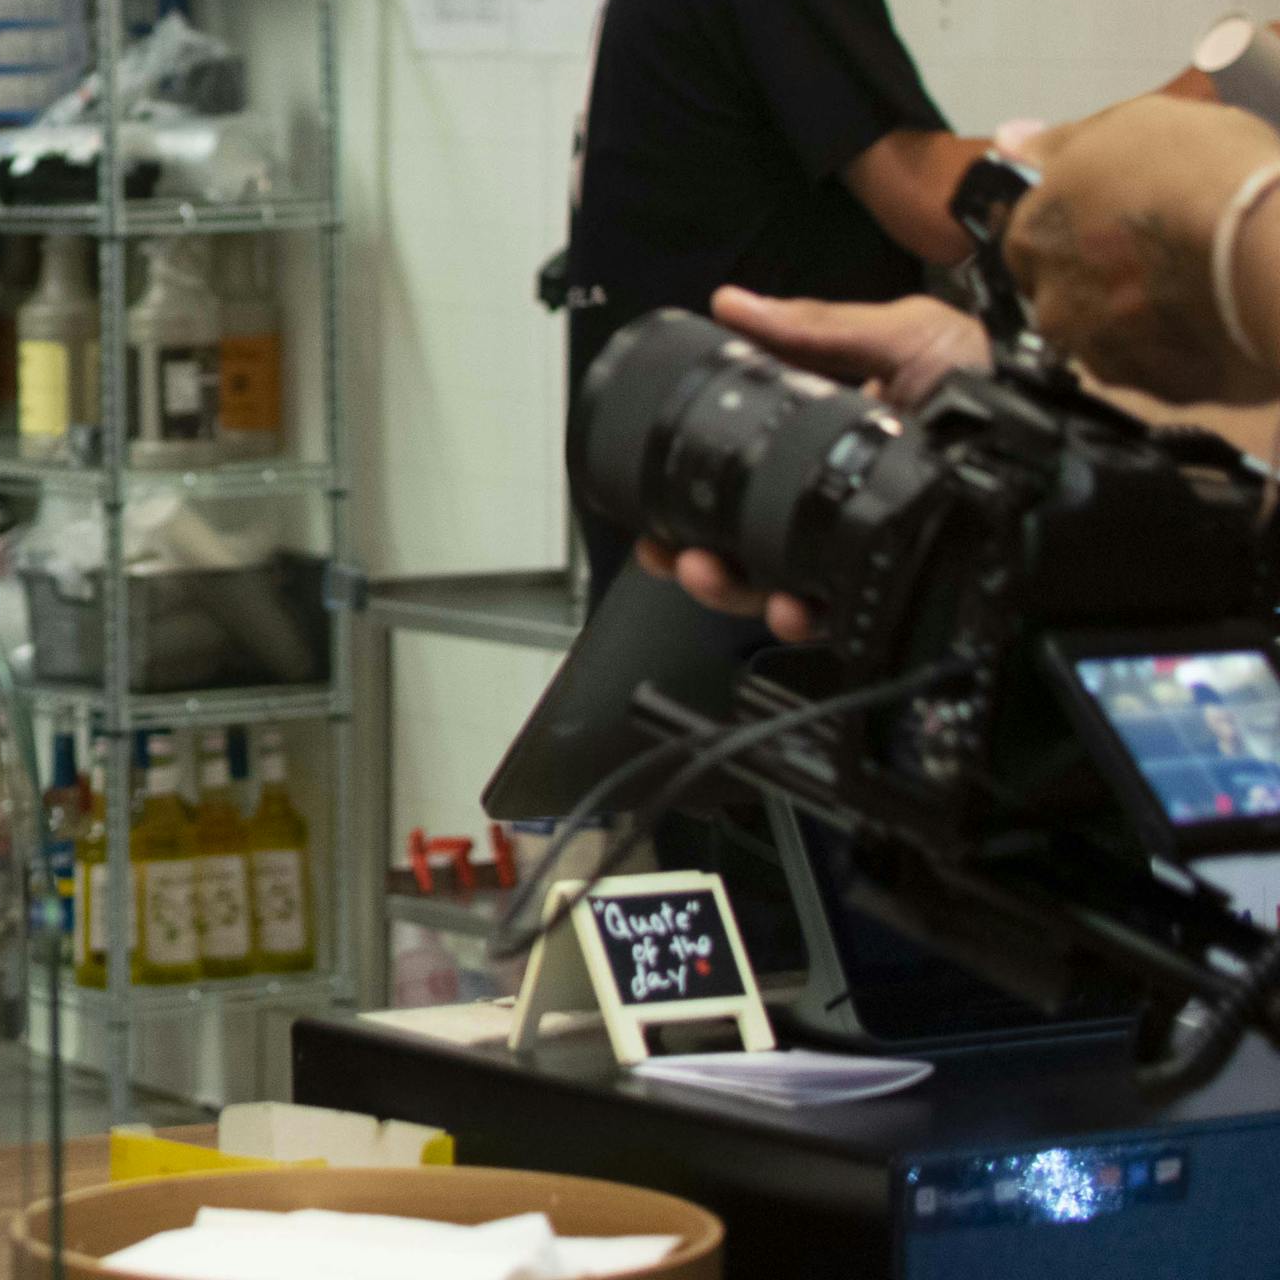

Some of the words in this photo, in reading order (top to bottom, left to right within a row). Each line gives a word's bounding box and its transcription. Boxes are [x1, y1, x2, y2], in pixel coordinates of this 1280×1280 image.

[631, 935, 659, 967] of
[669, 933, 712, 962] the
[630, 961, 688, 1001] day
